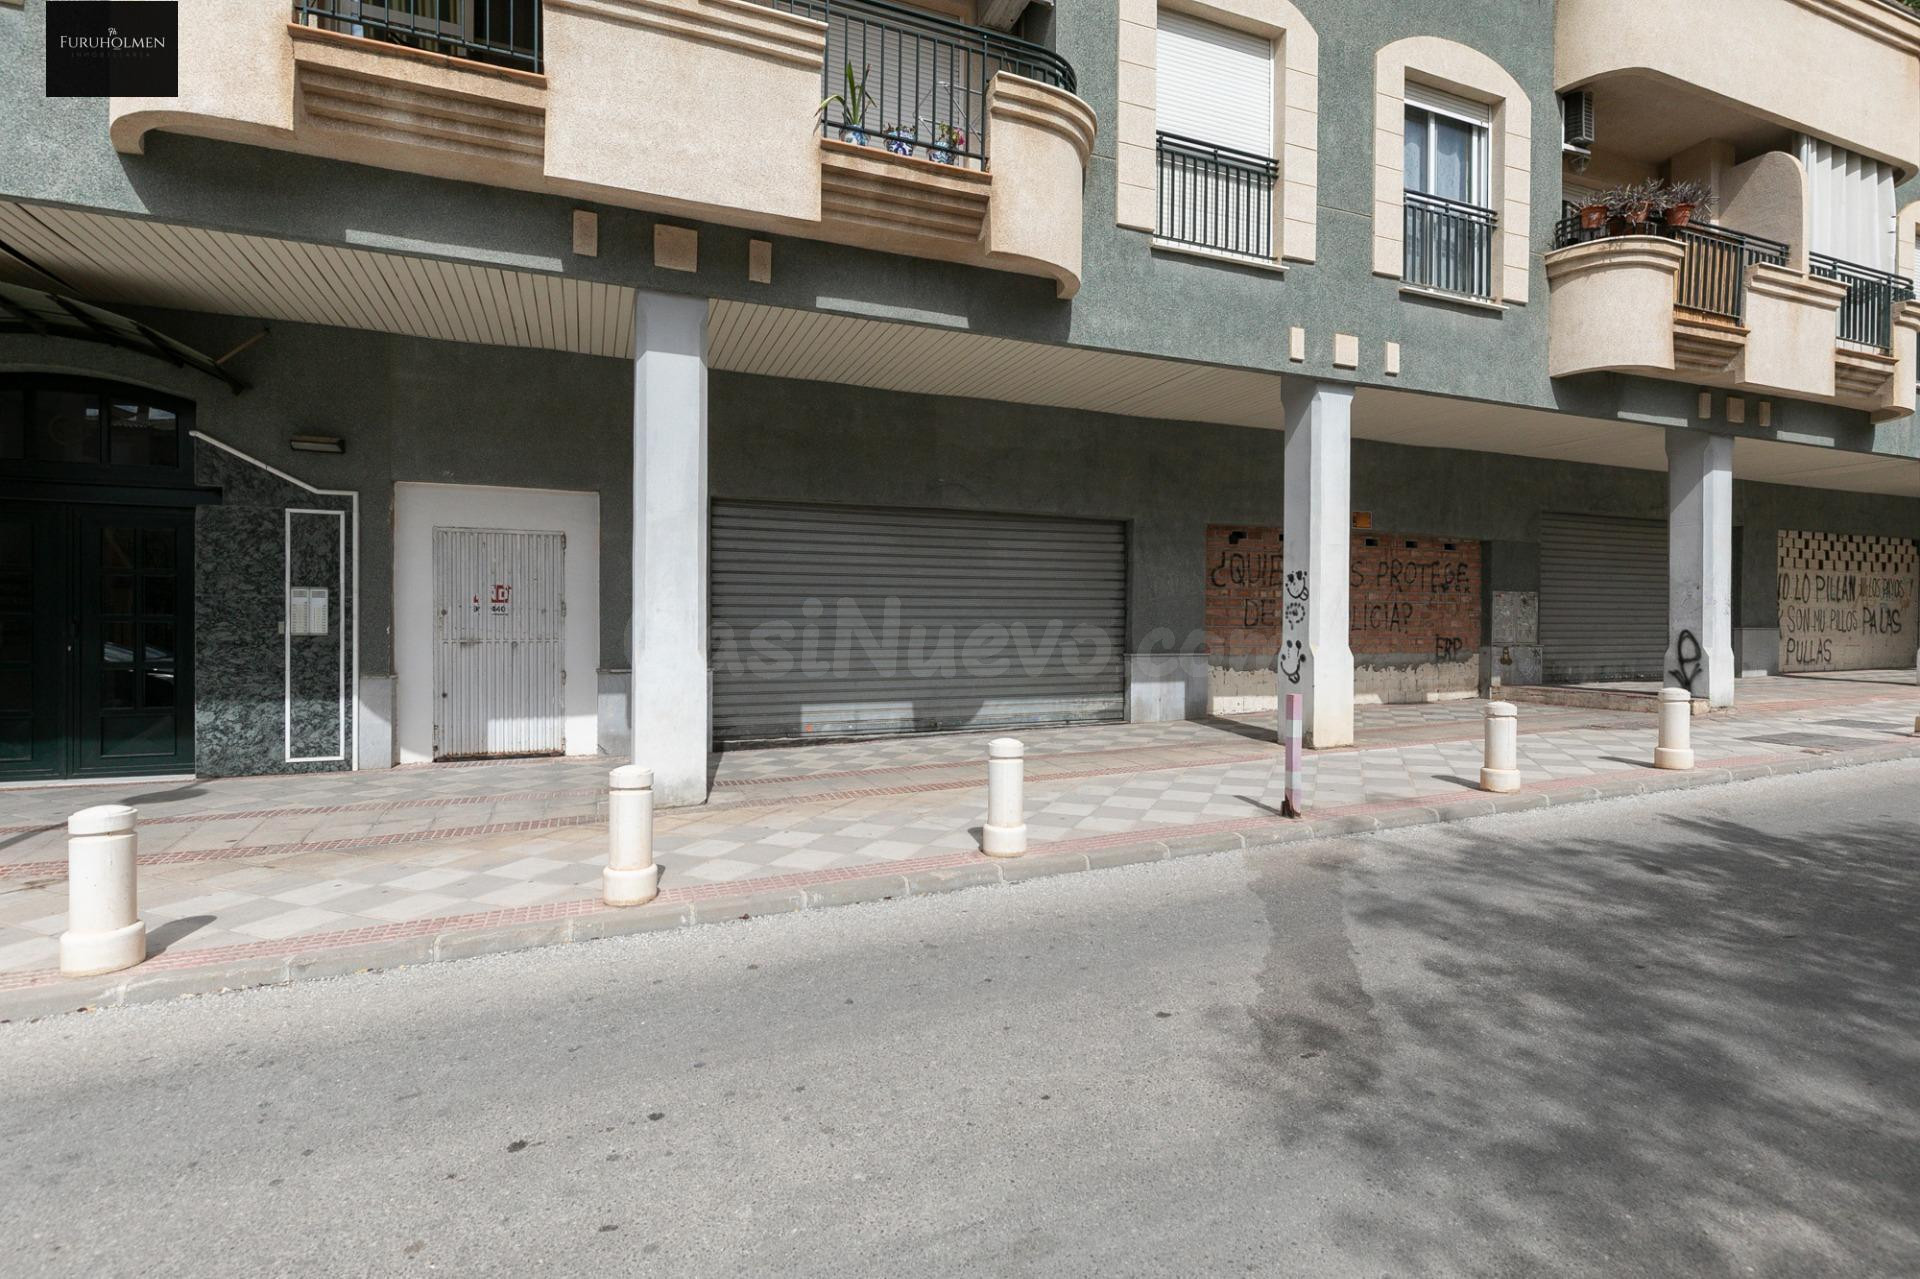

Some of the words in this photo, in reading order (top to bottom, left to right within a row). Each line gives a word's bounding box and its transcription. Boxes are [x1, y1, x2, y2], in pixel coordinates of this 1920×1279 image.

[1815, 575, 1856, 602] PILLAN
[1244, 598, 1277, 627] DE
[1786, 605, 1811, 634] SON
[1786, 637, 1833, 666] PULLAS
